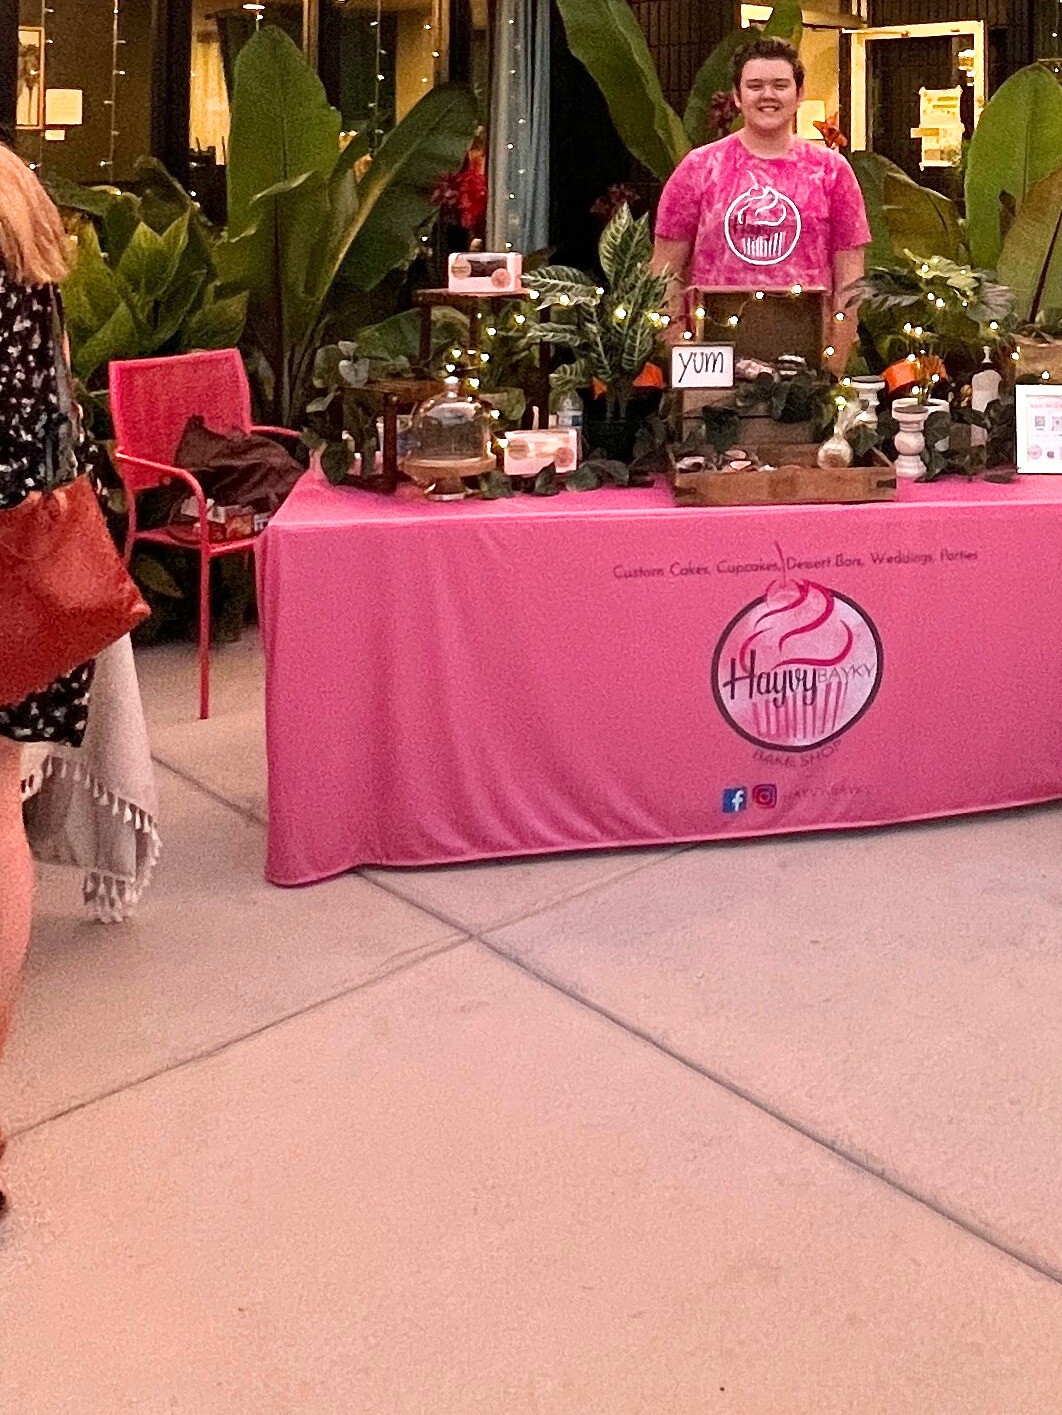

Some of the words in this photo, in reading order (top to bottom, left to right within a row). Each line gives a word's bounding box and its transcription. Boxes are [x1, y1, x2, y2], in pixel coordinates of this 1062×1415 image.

[613, 564, 665, 579] Custom
[786, 556, 831, 571] Dessert
[722, 649, 818, 708] Hayvy
[817, 662, 877, 684] BAYKY
